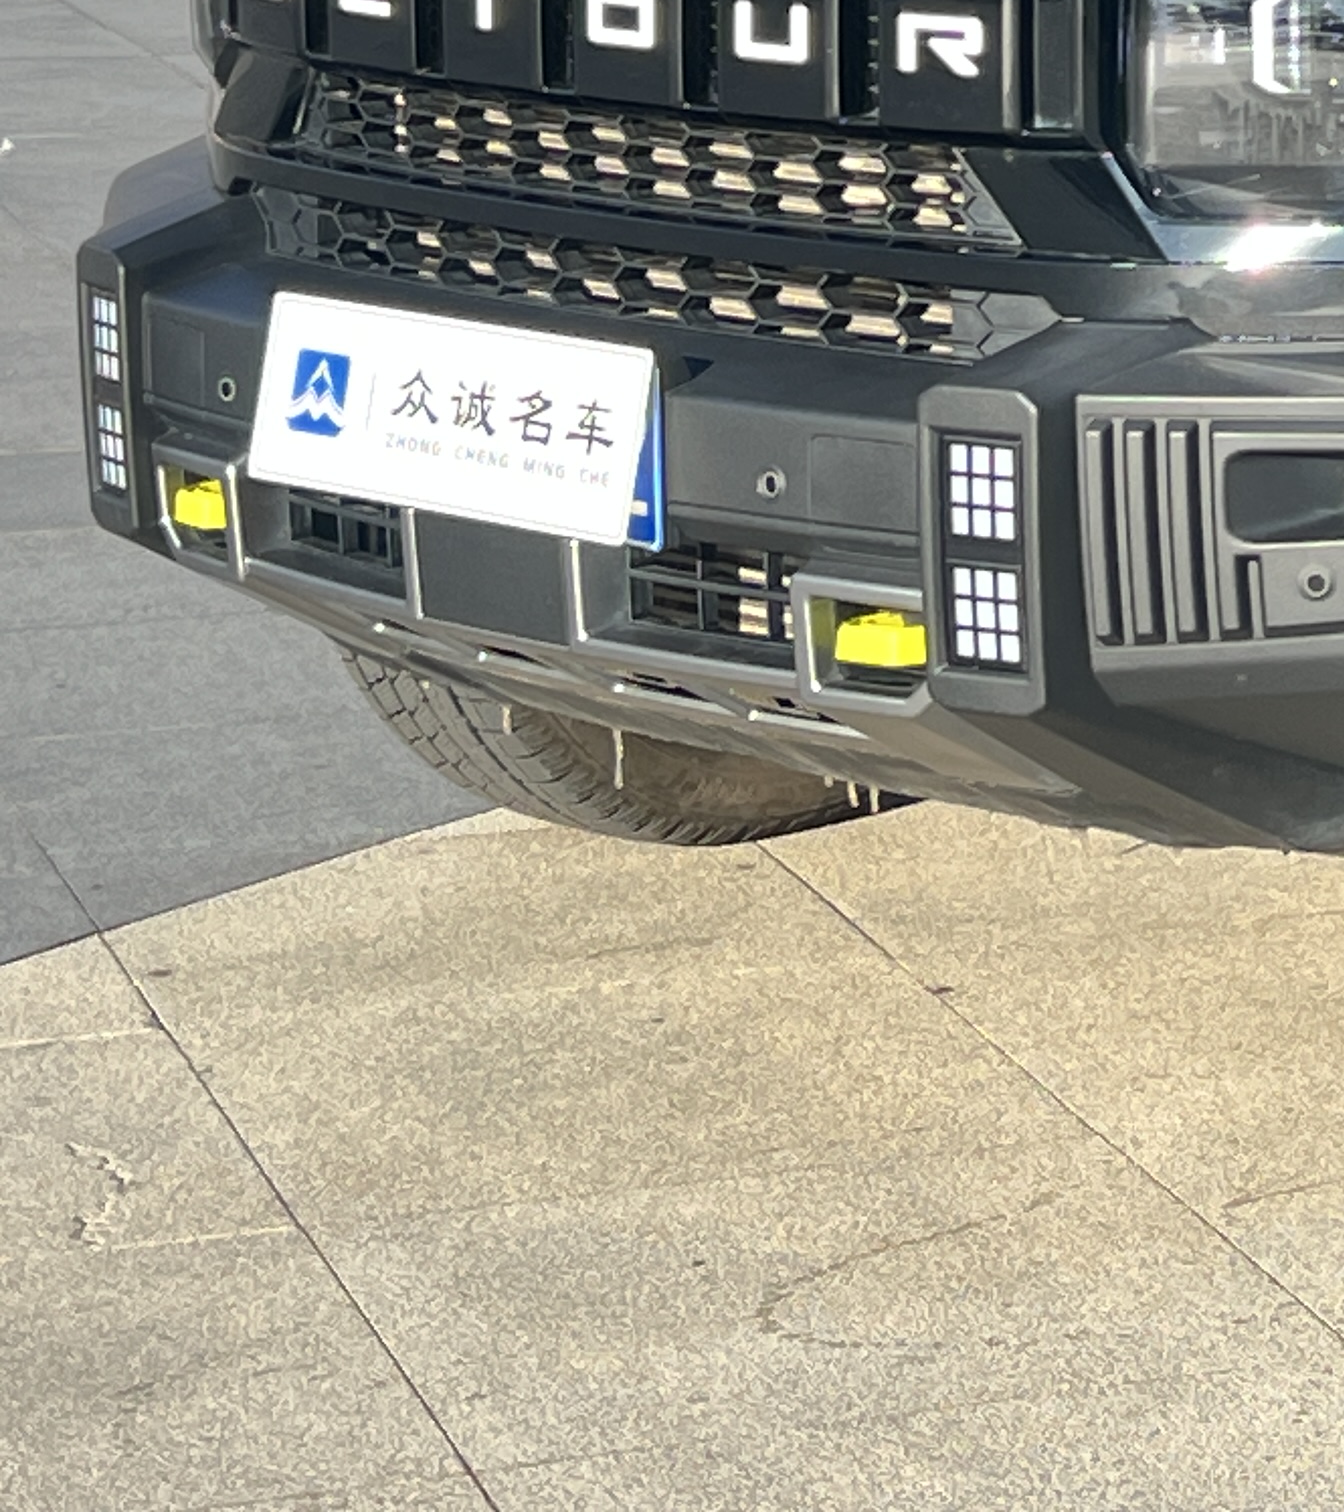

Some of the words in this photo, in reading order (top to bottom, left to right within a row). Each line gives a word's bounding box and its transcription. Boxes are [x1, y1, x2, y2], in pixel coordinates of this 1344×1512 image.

[389, 368, 615, 456] 众诚名车
[385, 432, 442, 457] ZHONG
[454, 444, 510, 469] CHENG
[522, 457, 566, 480] MING
[579, 467, 611, 488] CHE
